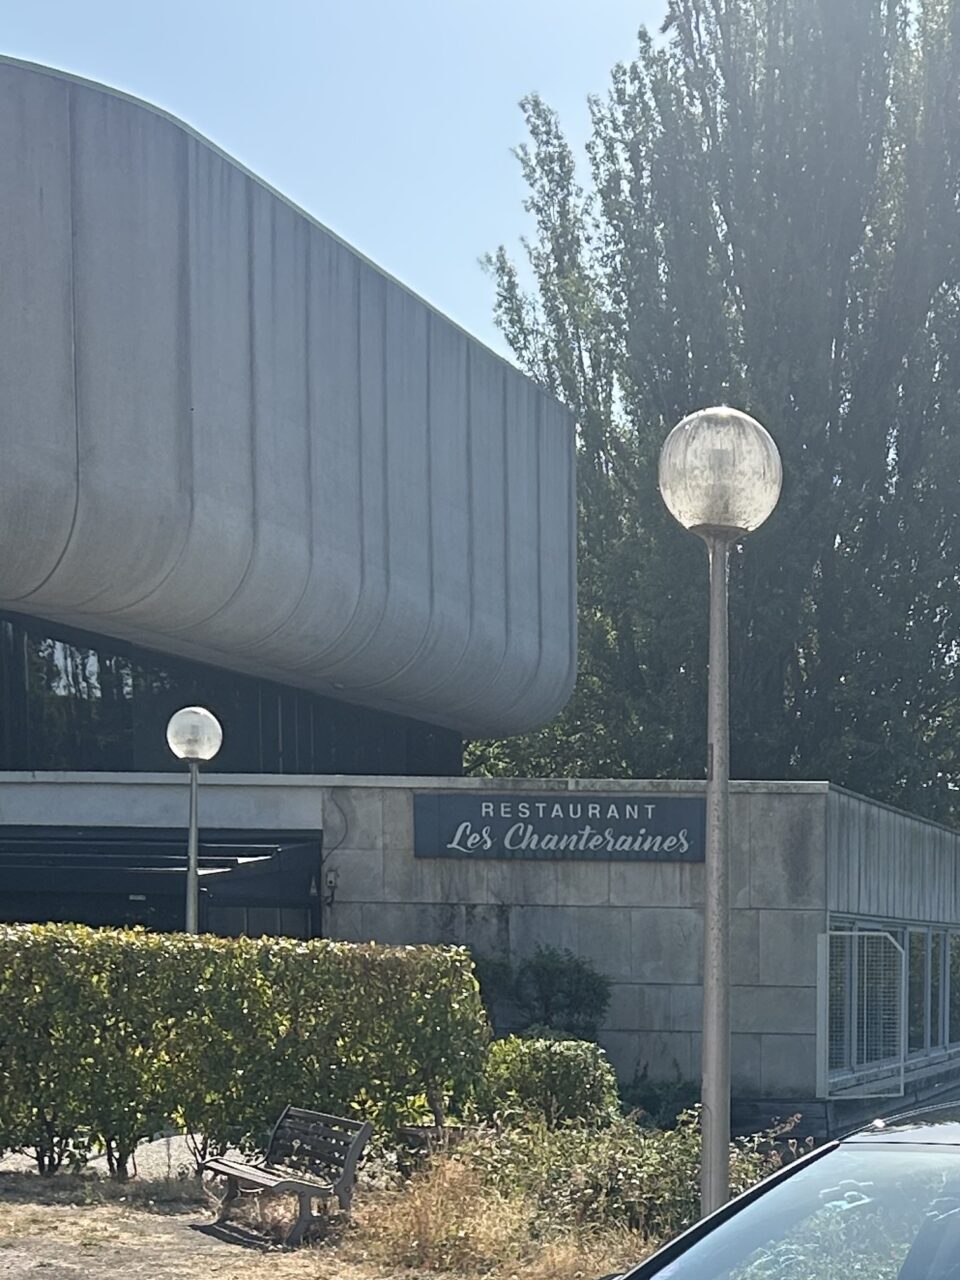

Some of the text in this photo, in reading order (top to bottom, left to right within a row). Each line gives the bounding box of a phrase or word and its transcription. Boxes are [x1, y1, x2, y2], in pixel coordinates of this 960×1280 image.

[481, 802, 656, 819] RESTAURANT
[446, 821, 693, 853] Les Chanteraines
